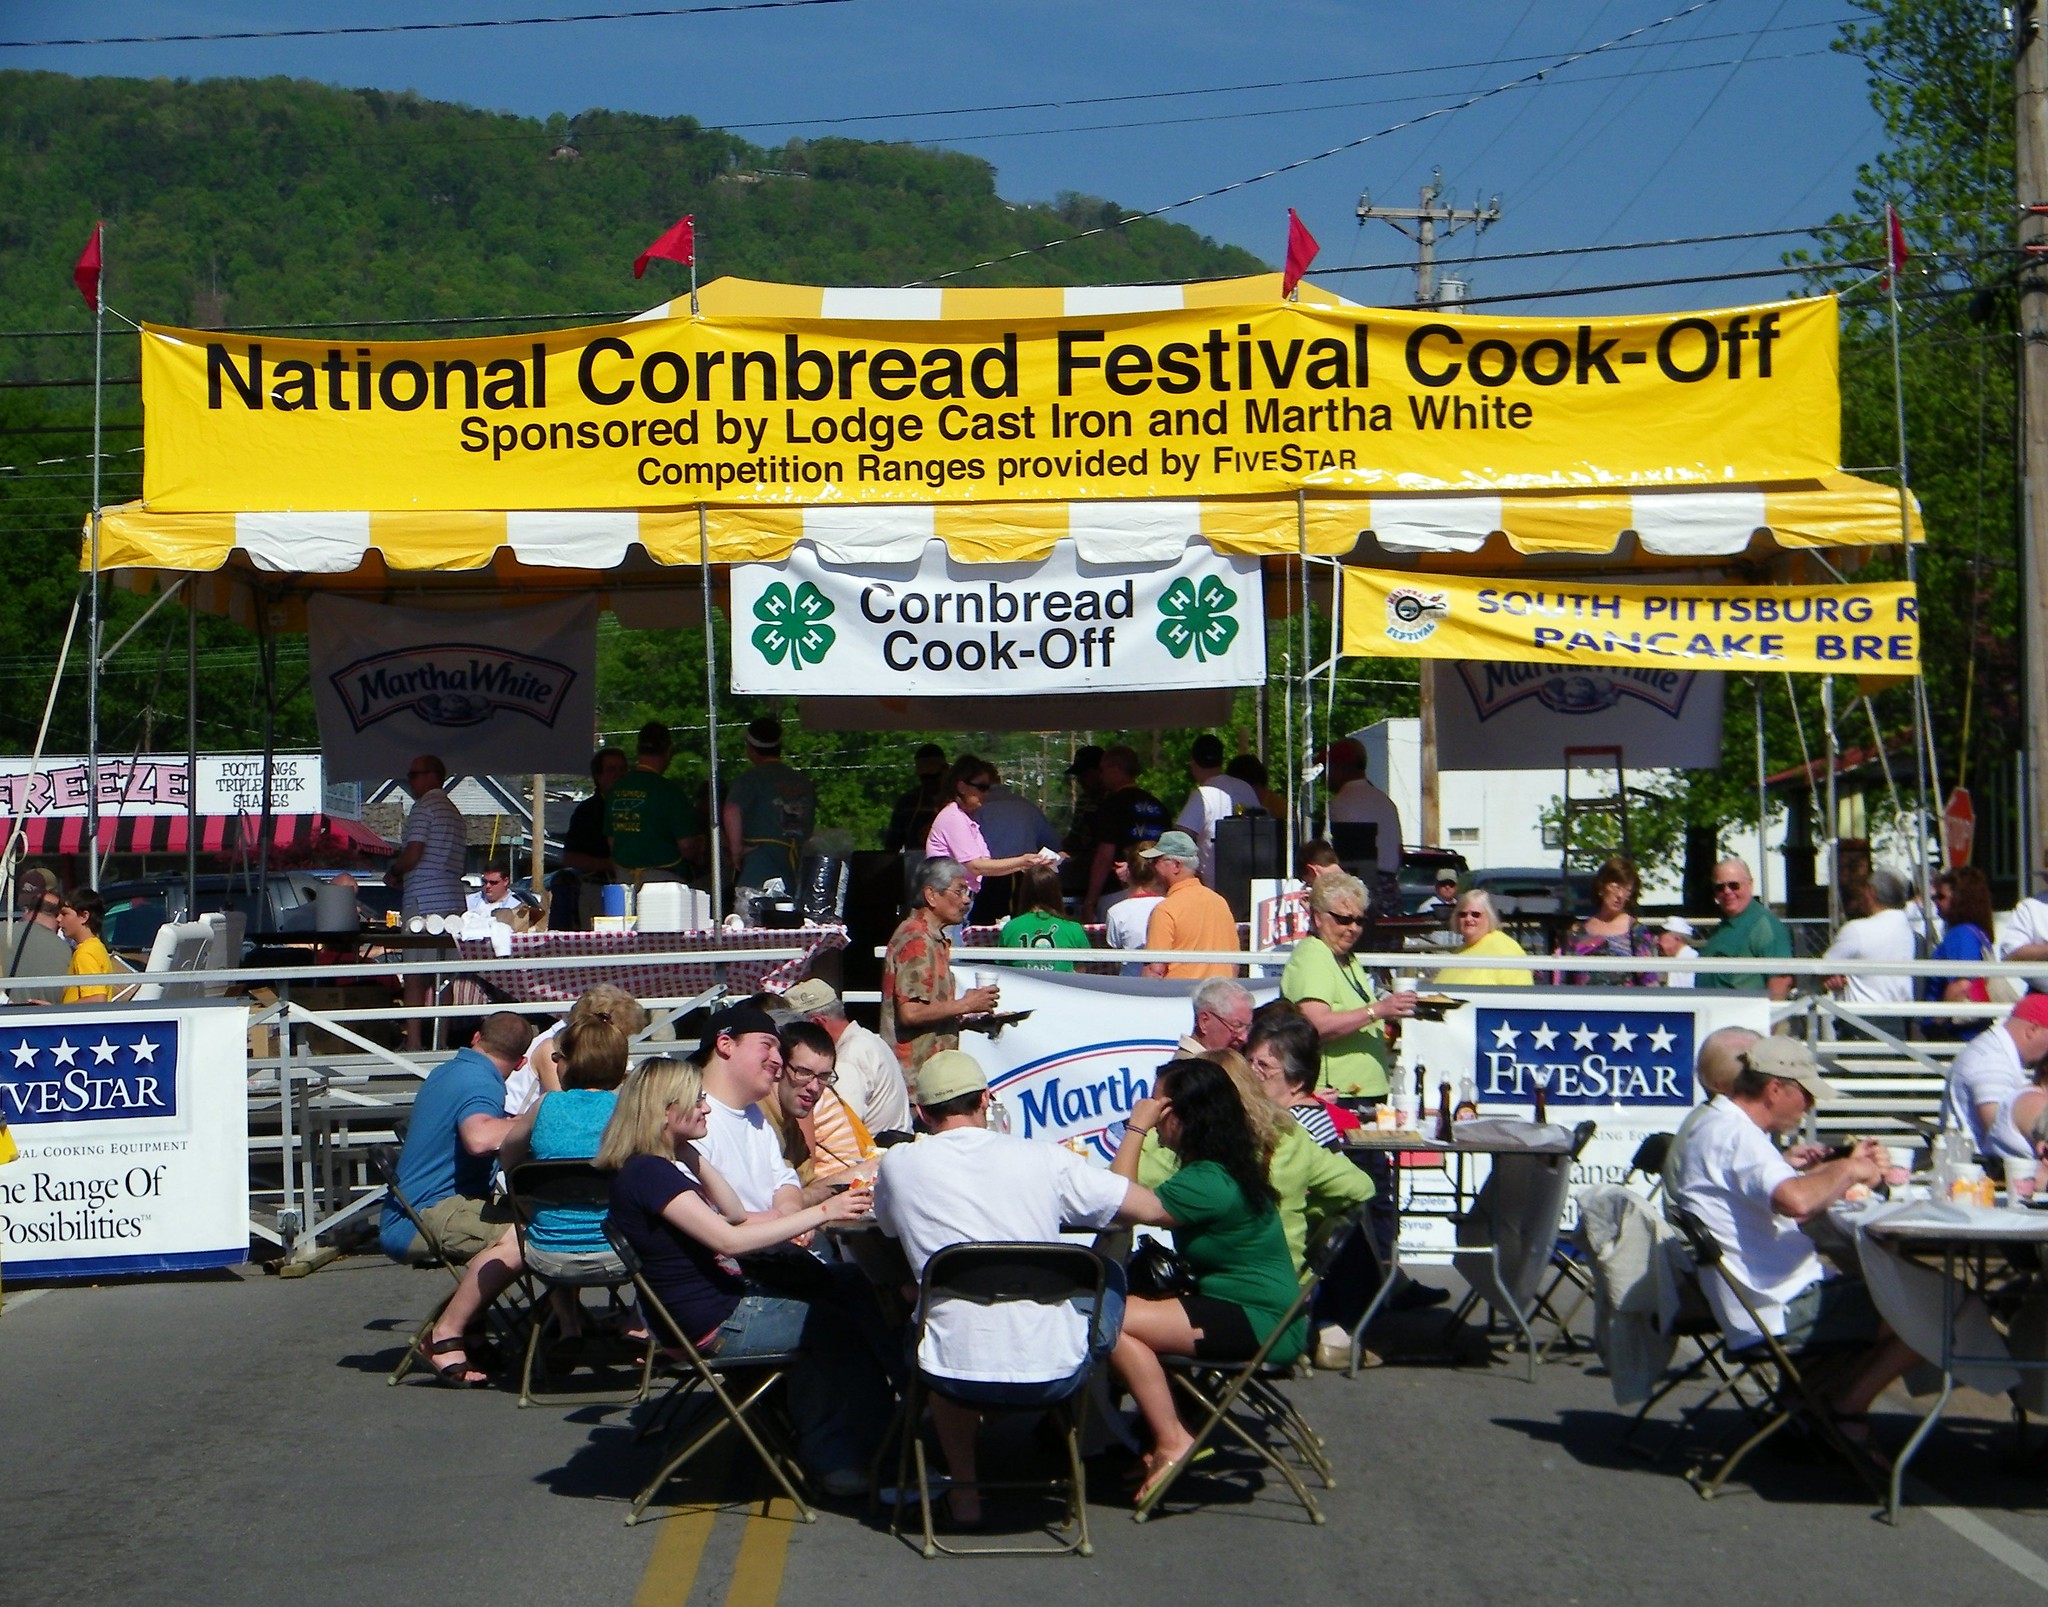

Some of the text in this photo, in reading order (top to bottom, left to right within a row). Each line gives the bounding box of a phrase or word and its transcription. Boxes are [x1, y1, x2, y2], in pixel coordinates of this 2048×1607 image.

[207, 312, 1780, 412] National Cornbread Festival Cook-Off
[460, 394, 1533, 461] Sponsored by Lodge Cast Iron and Martha White
[637, 453, 843, 490] Competition
[858, 452, 985, 487] Ranges
[1000, 448, 1148, 485] provided
[1161, 447, 1200, 482] by
[860, 580, 1134, 624] Cornbread
[1477, 589, 1622, 620] SOUTH
[1644, 596, 1873, 623] PITTSBURG
[884, 625, 1115, 672] Cook-Off
[1534, 627, 1914, 661] PANCAKE BRE
[222, 761, 297, 776] FOOTLNGS
[233, 793, 290, 808] SHAES
[0, 1069, 166, 1115] VESTAR
[1017, 1066, 1149, 1140] Marth
[43, 1145, 105, 1158] COOKING
[110, 1140, 188, 1155] EQUIPMENT
[32, 1172, 119, 1209] Range
[125, 1164, 167, 1198] Of
